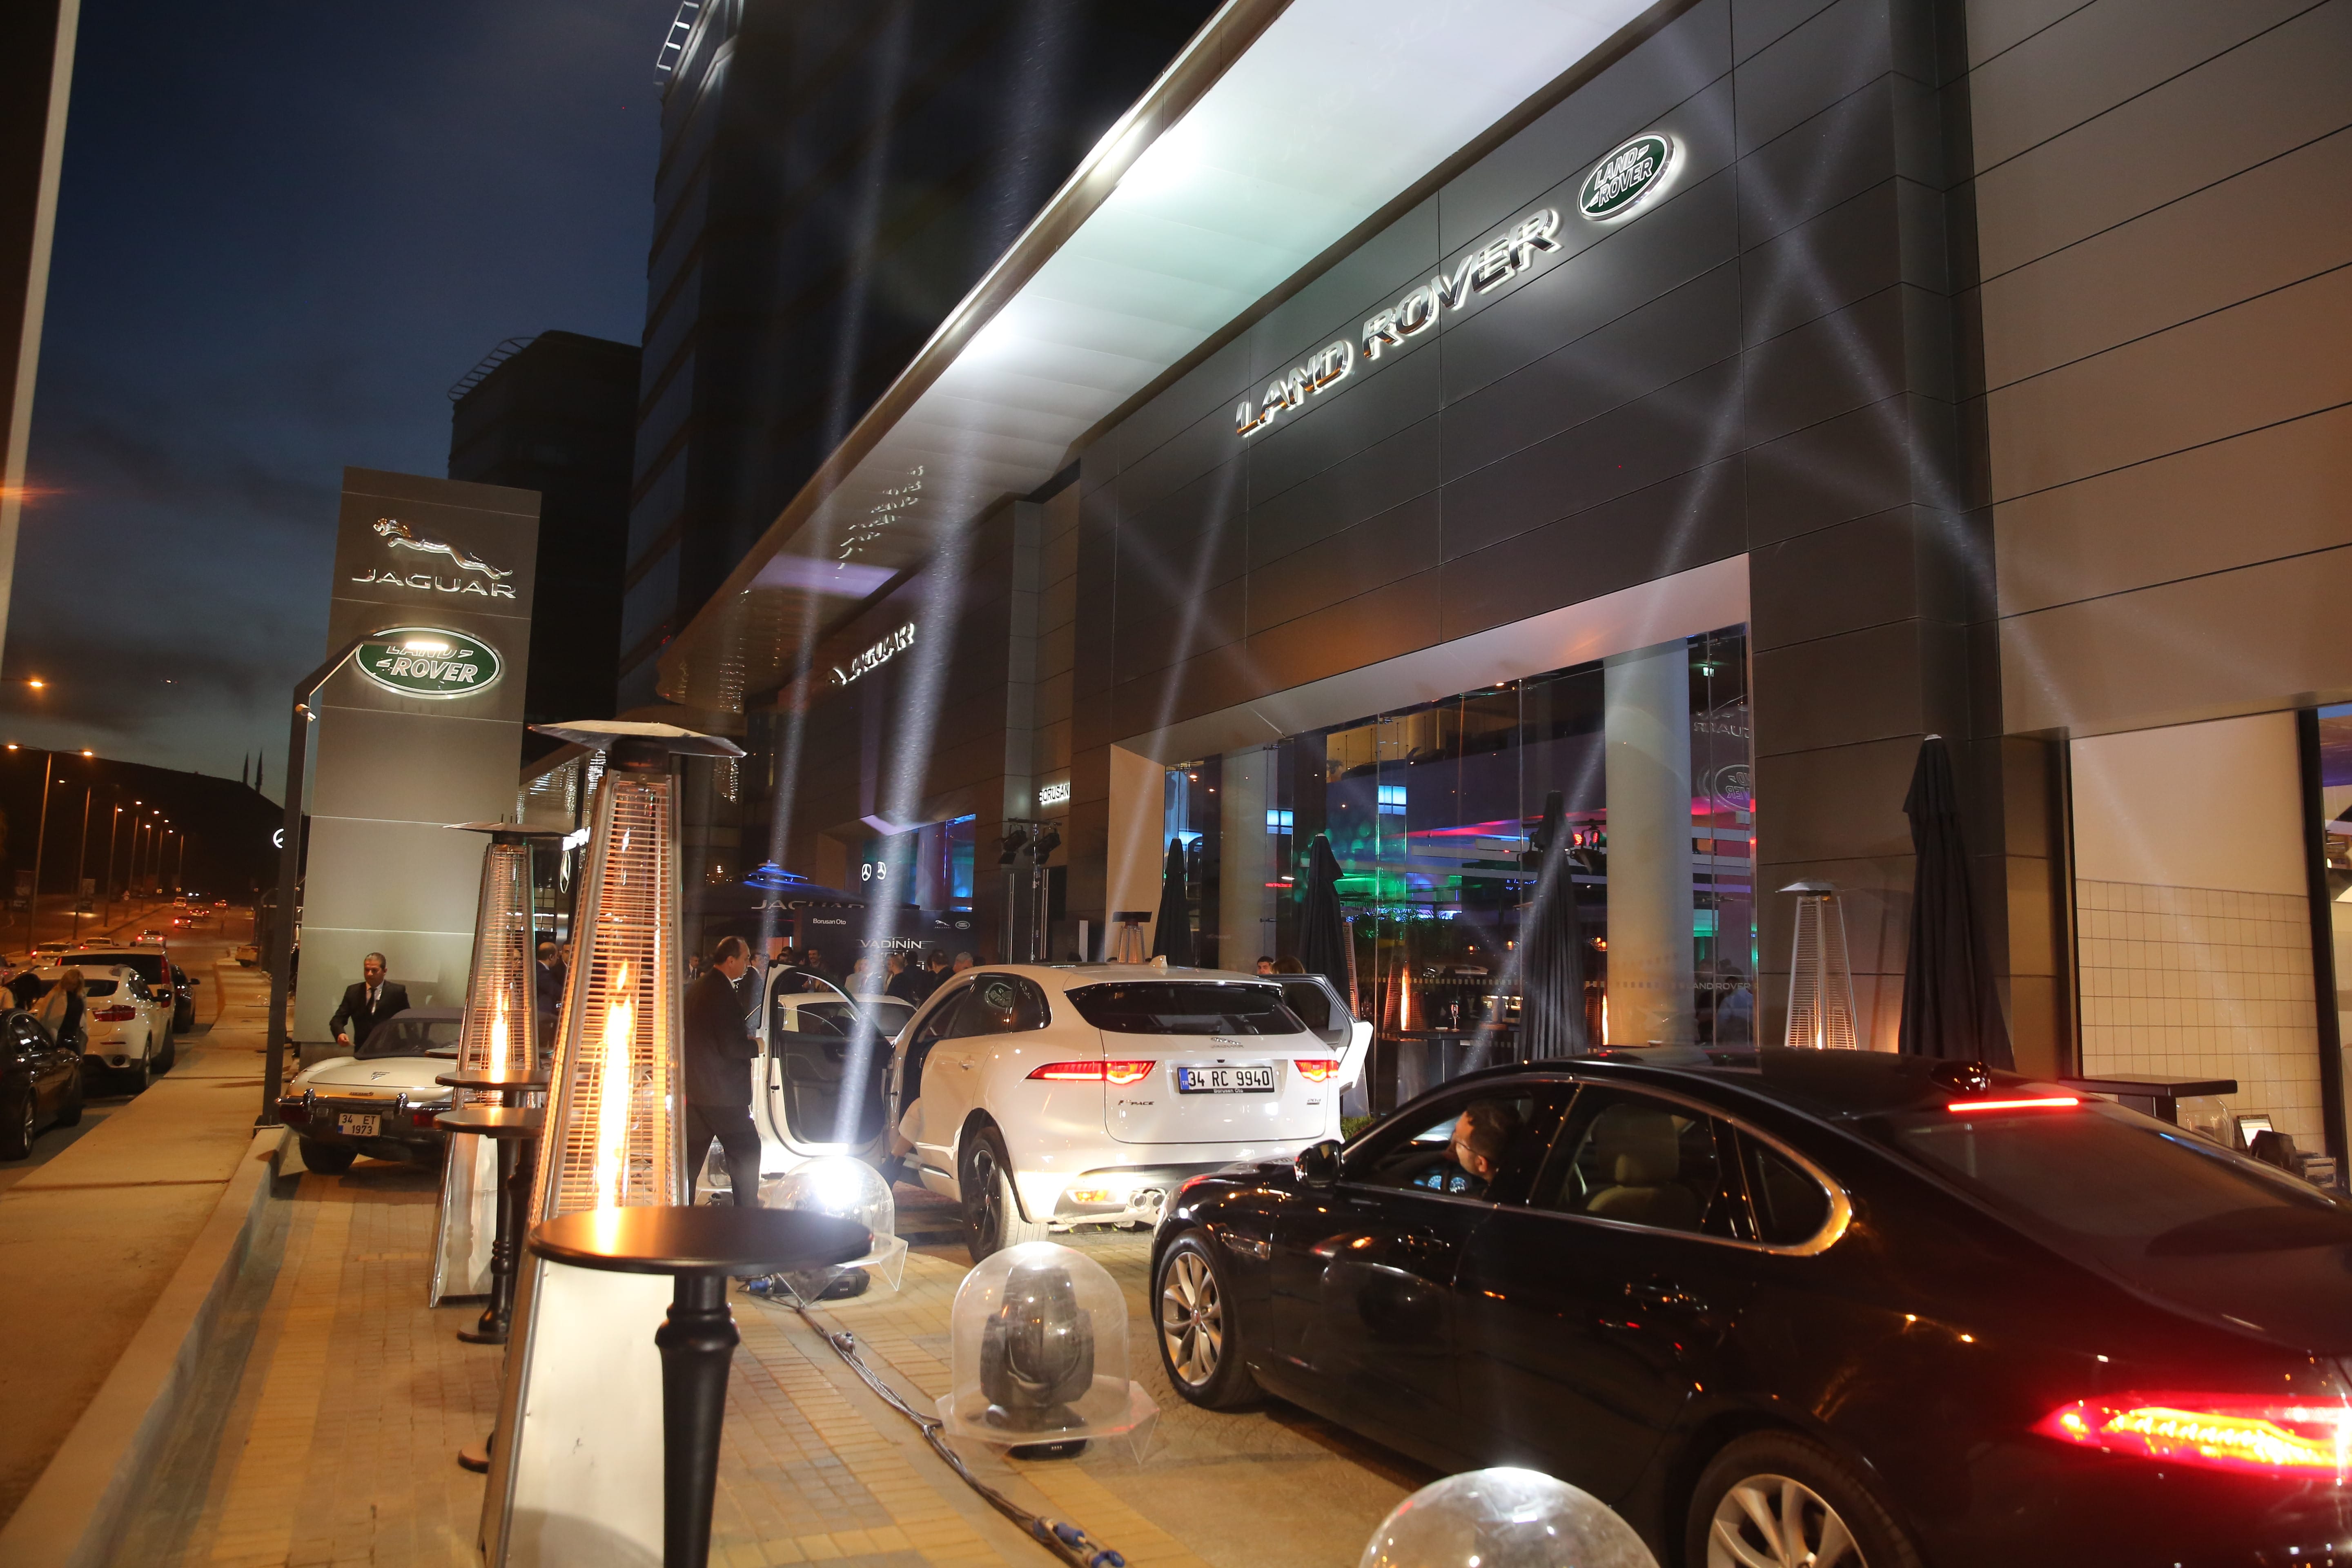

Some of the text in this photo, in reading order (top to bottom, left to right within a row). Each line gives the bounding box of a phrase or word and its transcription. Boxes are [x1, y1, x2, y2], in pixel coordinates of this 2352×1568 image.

[1594, 147, 1638, 191] LAND
[1598, 157, 1653, 207] ROVER
[1236, 208, 1562, 437] LAND ROVER
[352, 569, 517, 599] JAGUAR
[390, 657, 478, 683] ROVER
[1038, 783, 1070, 803] BORUSAN
[1188, 1071, 1270, 1087] 34 RC 9940
[342, 1115, 376, 1125] 34 ET
[352, 1125, 372, 1134] 1973
